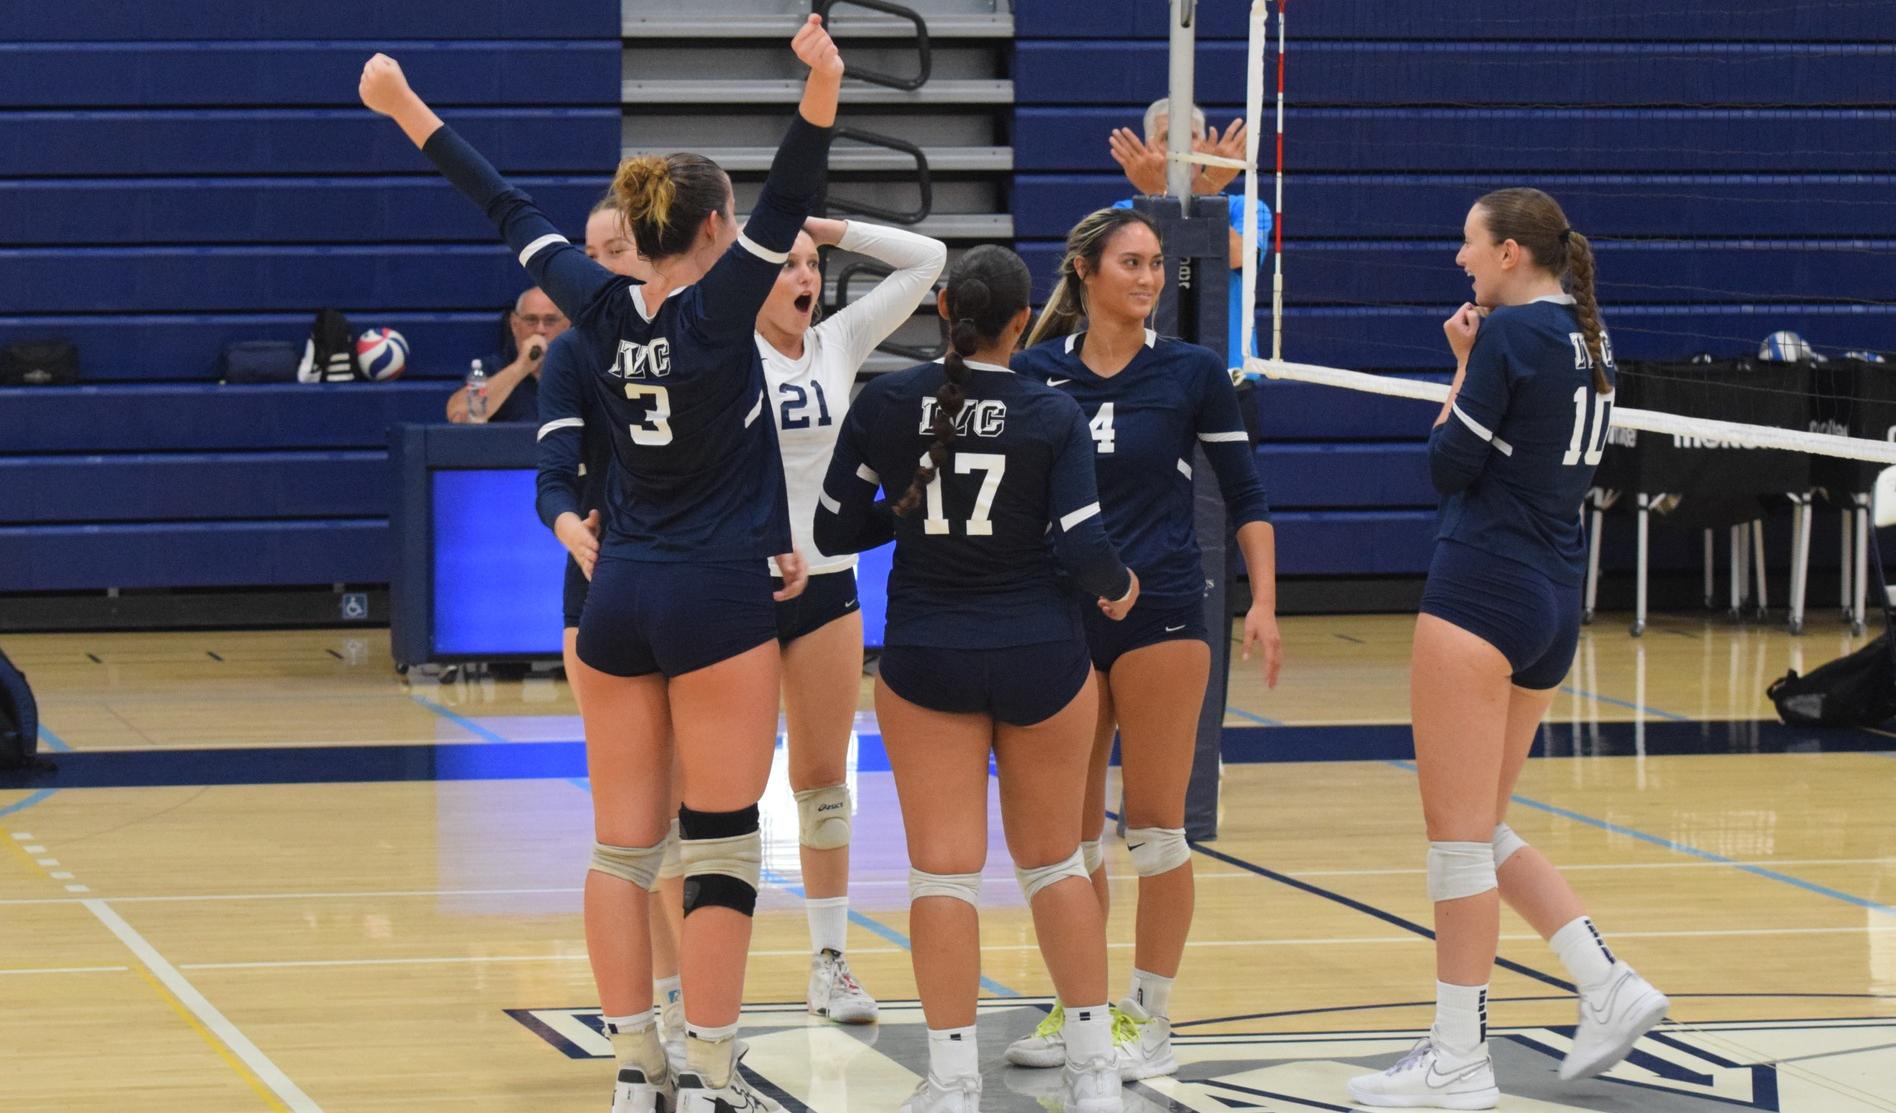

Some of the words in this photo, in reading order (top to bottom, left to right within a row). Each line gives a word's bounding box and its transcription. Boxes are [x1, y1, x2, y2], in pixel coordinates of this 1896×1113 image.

[624, 383, 673, 446] 3
[779, 379, 832, 430] 21
[1088, 402, 1115, 453] 4
[1562, 386, 1615, 465] 10
[919, 451, 1006, 536] 17
